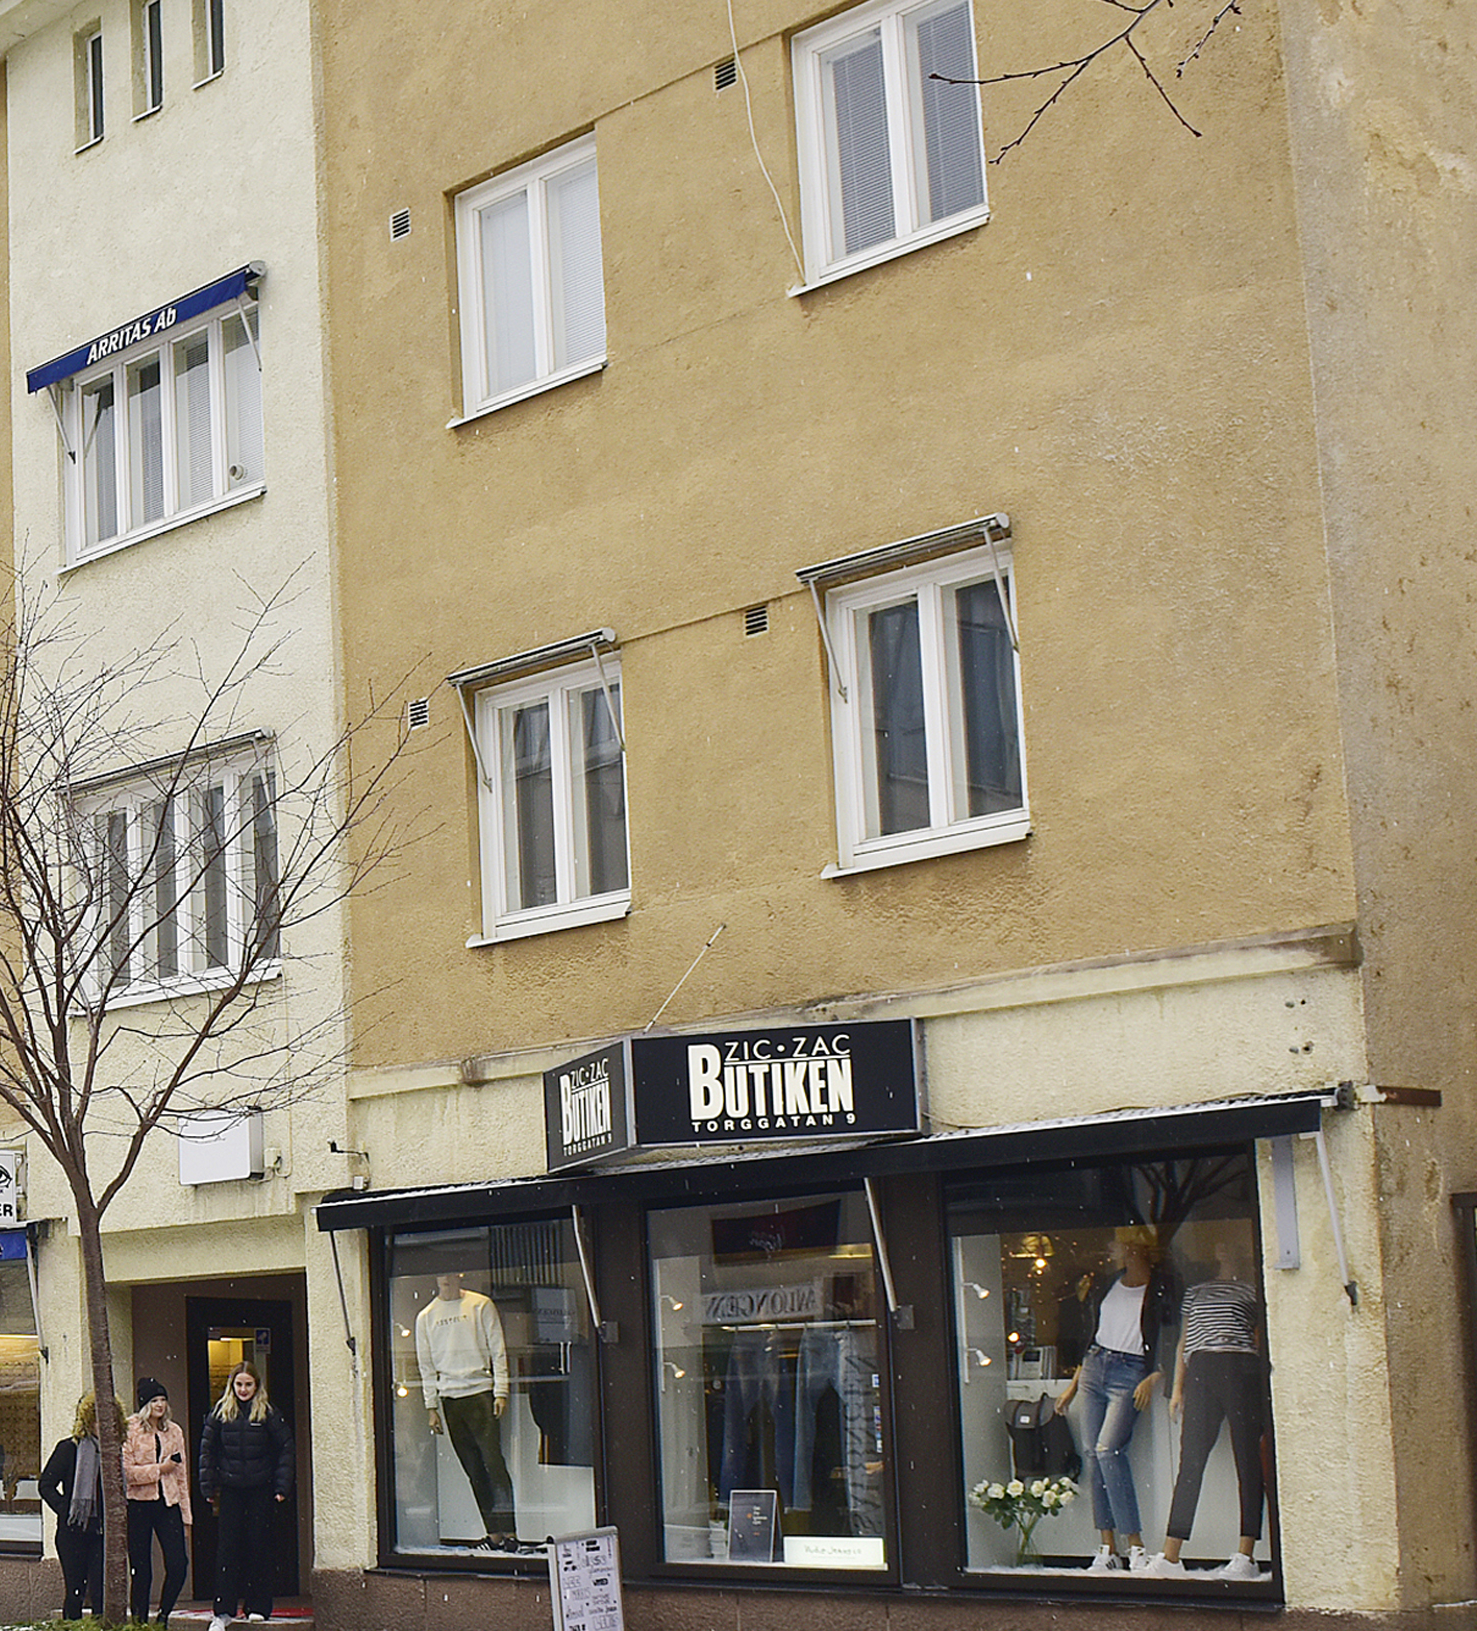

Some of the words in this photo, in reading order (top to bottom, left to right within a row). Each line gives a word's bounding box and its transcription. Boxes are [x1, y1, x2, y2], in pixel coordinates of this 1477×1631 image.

[86, 317, 152, 365] ARRITAS
[559, 1074, 612, 1146] BUTIKEN
[687, 1043, 854, 1120] BUTIKEN
[691, 1114, 833, 1133] TORGGATAN
[846, 1112, 856, 1125] 9
